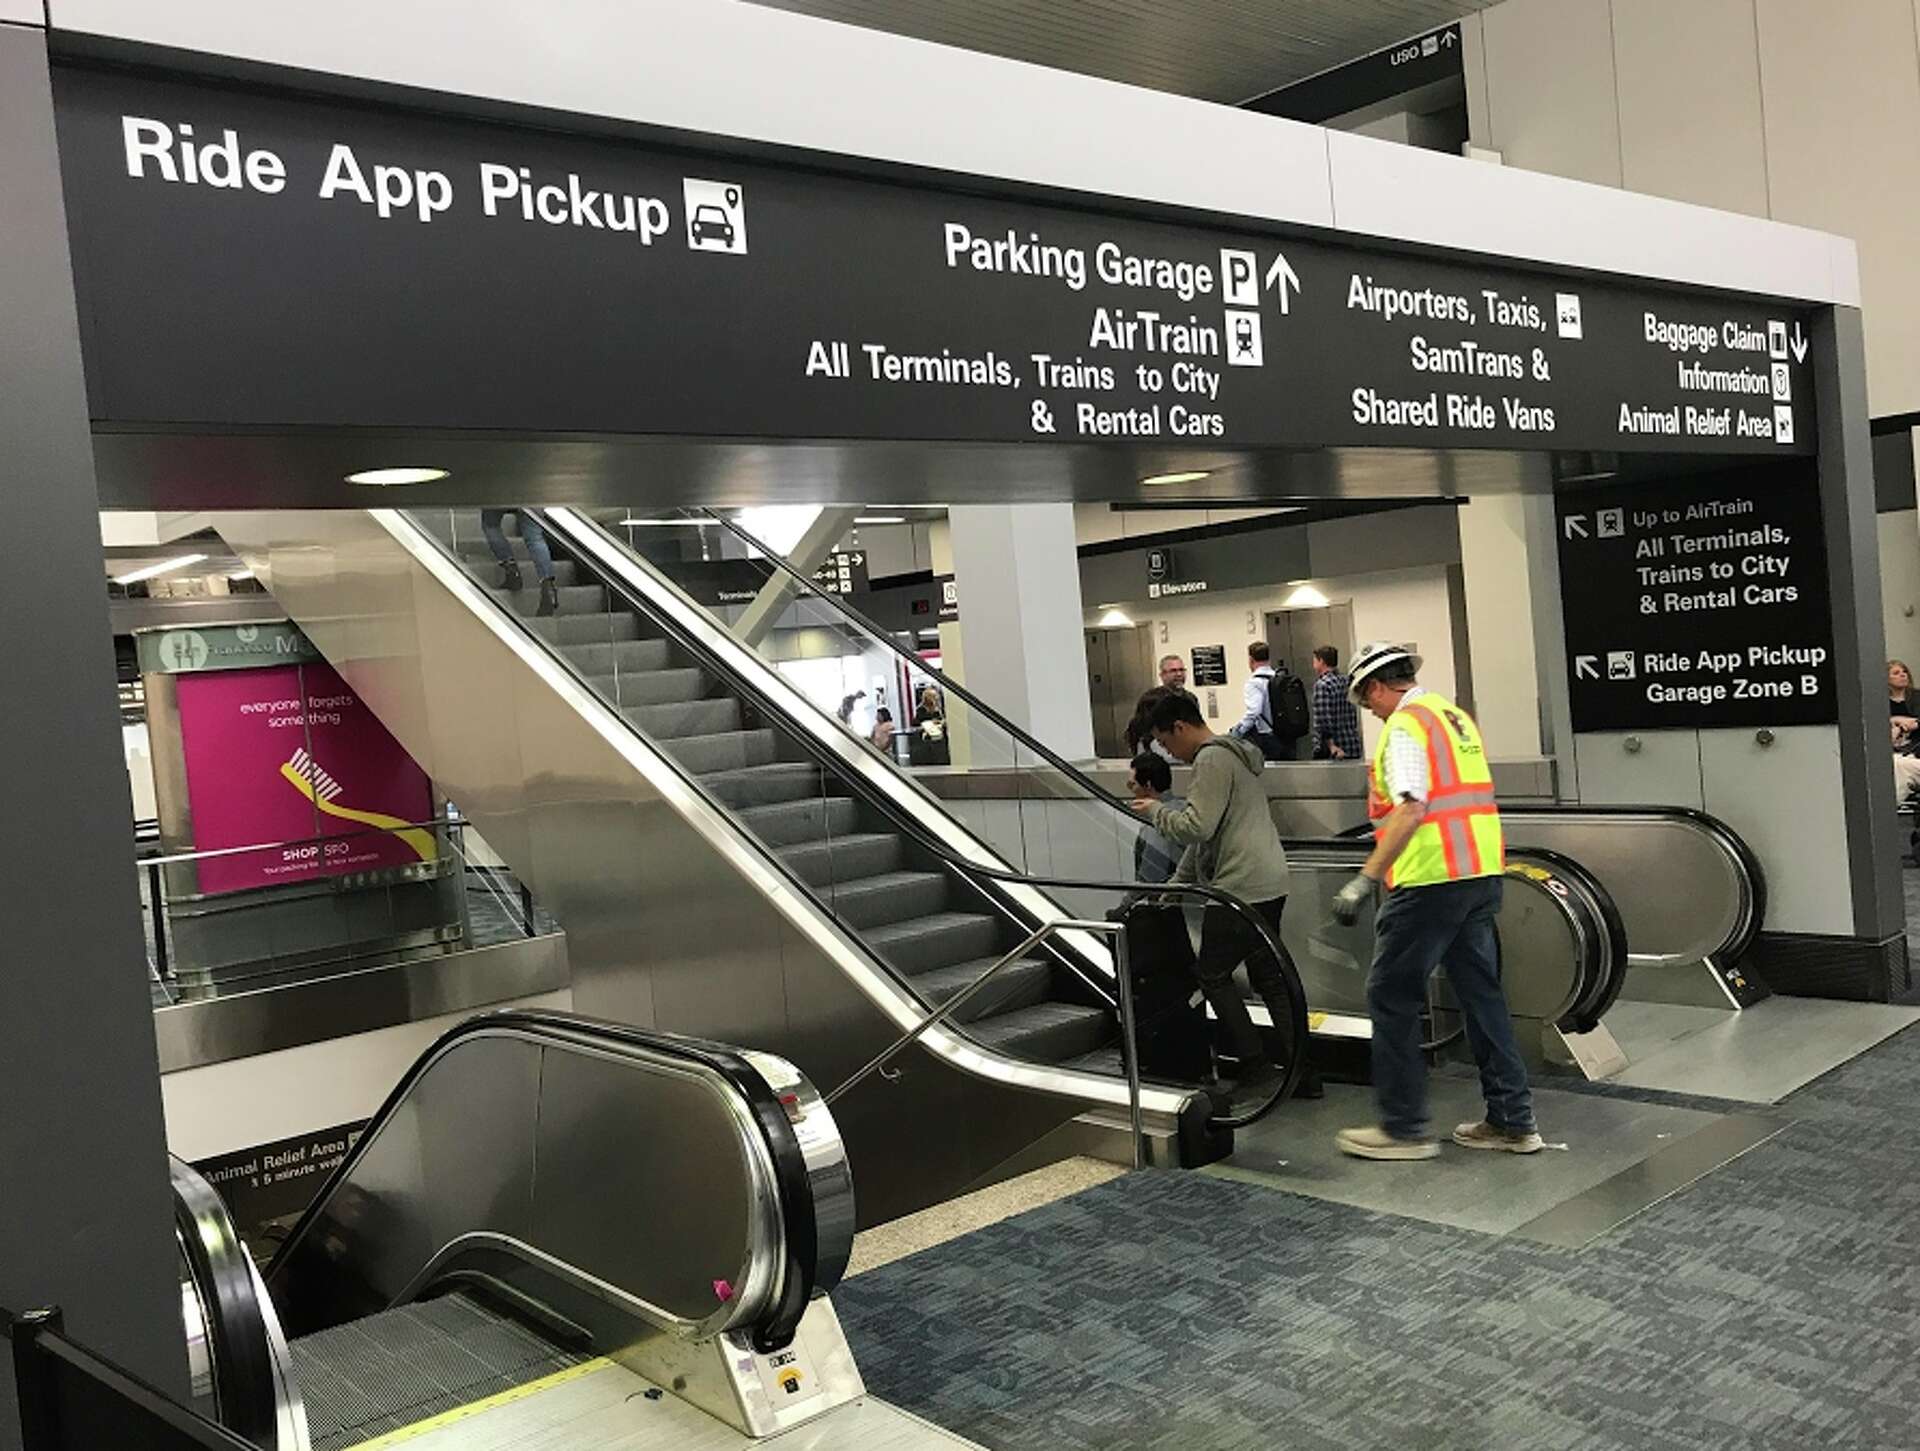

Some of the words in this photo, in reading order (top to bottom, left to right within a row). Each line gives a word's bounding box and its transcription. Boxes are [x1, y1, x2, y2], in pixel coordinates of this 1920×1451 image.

[1390, 45, 1419, 65] USO
[122, 116, 286, 193] Ride
[319, 144, 453, 222] App
[480, 162, 670, 245] Pickup
[944, 222, 1086, 290] Parking
[1096, 241, 1213, 301] Garage
[1347, 274, 1476, 326] Airporters,
[1482, 289, 1547, 332] Taxis,
[1090, 307, 1218, 356] AirTrain
[1644, 312, 1718, 353] Baggage
[1723, 320, 1766, 351] Claim
[805, 341, 850, 377] All
[862, 344, 1021, 389] Terminals,
[1031, 354, 1115, 391] Trains
[1136, 364, 1163, 392] to
[1172, 363, 1221, 400] City
[1411, 335, 1523, 379] SamTrans
[1531, 347, 1551, 381] &
[1678, 360, 1770, 394] Information
[1031, 400, 1056, 433] &
[1078, 403, 1160, 435] Rental
[1169, 406, 1224, 436] Cars
[1352, 388, 1439, 427] Shared
[1446, 394, 1496, 429] Ride
[1502, 396, 1556, 432] Vans
[1618, 402, 1680, 434] Animal
[1685, 406, 1731, 436] Relief
[1737, 409, 1773, 437] Area
[1633, 510, 1658, 528] Up
[1662, 508, 1681, 523] to
[1685, 498, 1754, 520] AirTrain
[1635, 539, 1665, 559] All
[1670, 524, 1791, 556] Terminals,
[1636, 565, 1704, 586] Trains
[1709, 561, 1734, 579] to
[1741, 555, 1791, 577] City
[1639, 595, 1658, 615] &
[1664, 587, 1736, 612] Rental
[1743, 583, 1799, 606] Cars
[1643, 653, 1691, 674] Ride
[1696, 650, 1742, 673] App
[1748, 644, 1827, 668] Pickup
[240, 700, 300, 714] everyone
[1646, 682, 1727, 705] Garage
[1732, 678, 1794, 699] Zone
[1800, 675, 1819, 695] B
[282, 846, 319, 861] SHOP
[205, 1159, 258, 1184] Animal
[263, 1148, 306, 1170] Relief
[311, 1141, 345, 1158] Area
